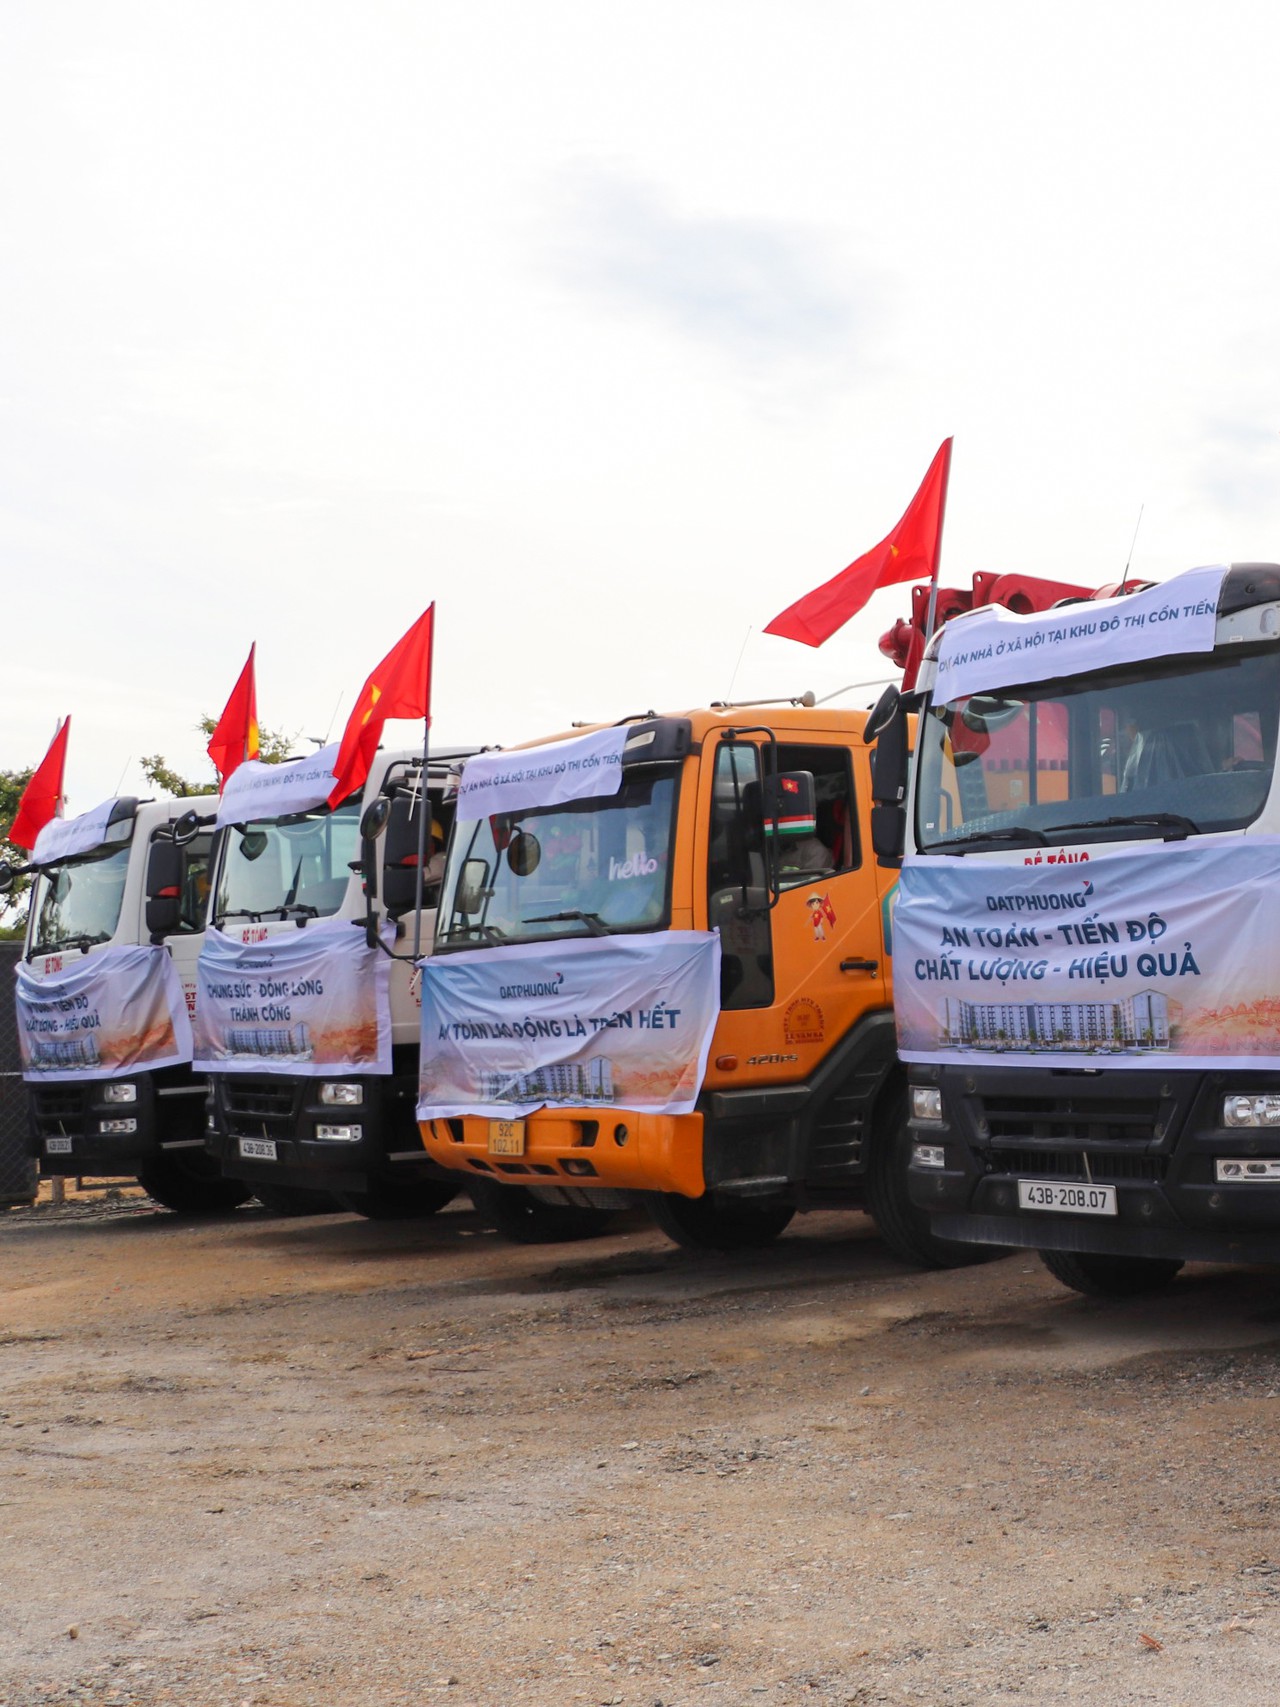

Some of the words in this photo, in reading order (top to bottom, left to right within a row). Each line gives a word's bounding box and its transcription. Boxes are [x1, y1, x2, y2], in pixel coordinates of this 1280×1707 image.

[952, 652, 969, 666] ÁN
[970, 644, 993, 662] NHÀ
[1007, 636, 1023, 653] XÃ
[1024, 632, 1045, 649] HỘI
[1048, 628, 1067, 644] TẠI
[1069, 622, 1097, 638] KHU
[1099, 616, 1121, 632] ĐÔ
[1124, 613, 1146, 628] THỊ
[1149, 605, 1179, 623] CỒN
[1183, 598, 1216, 617] TIẾN
[986, 892, 1087, 911] DATPHUONG
[940, 926, 970, 948] AN
[973, 922, 1040, 948] TOÀN
[1057, 912, 1120, 945] TIẾN
[1126, 912, 1168, 945] ĐỘ
[915, 950, 962, 981] CHẤT
[968, 957, 1049, 986] LƯỢNG
[1068, 950, 1128, 984] HIỆU
[1136, 942, 1201, 977] QUẢ
[261, 1002, 291, 1021] CÔNG
[563, 1014, 587, 1037] LÀ
[639, 1001, 681, 1029] HẾT
[1028, 1186, 1107, 1209] 43B-208.07
